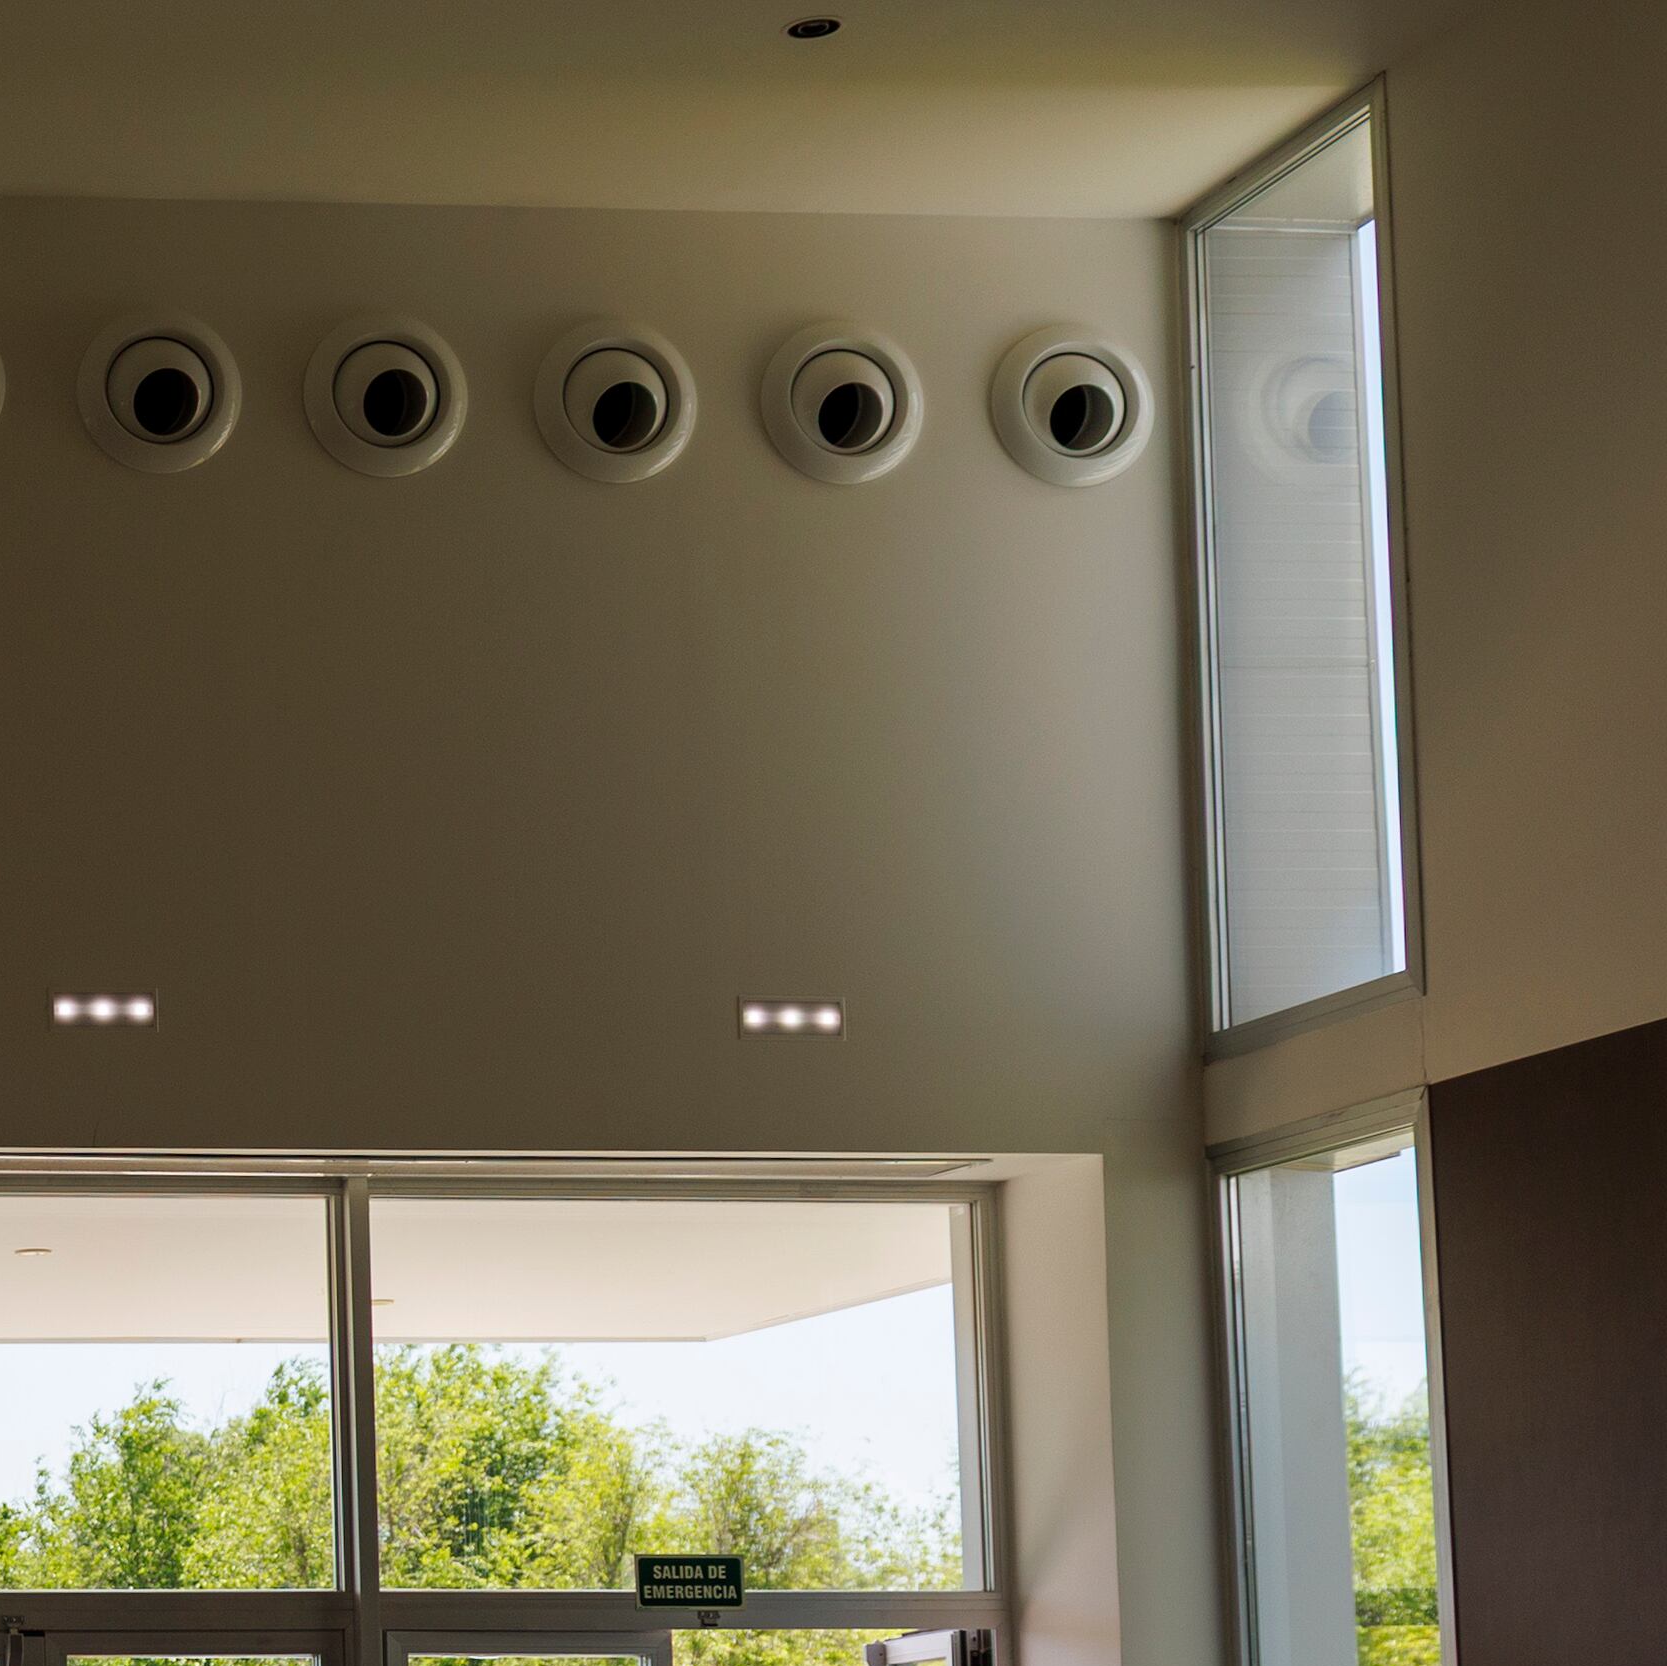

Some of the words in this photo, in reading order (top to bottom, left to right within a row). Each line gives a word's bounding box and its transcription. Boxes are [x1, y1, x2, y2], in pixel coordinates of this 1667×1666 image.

[652, 1565, 704, 1580] SALIDA
[708, 1565, 727, 1580] DE
[643, 1585, 738, 1600] EMERGENCIA
